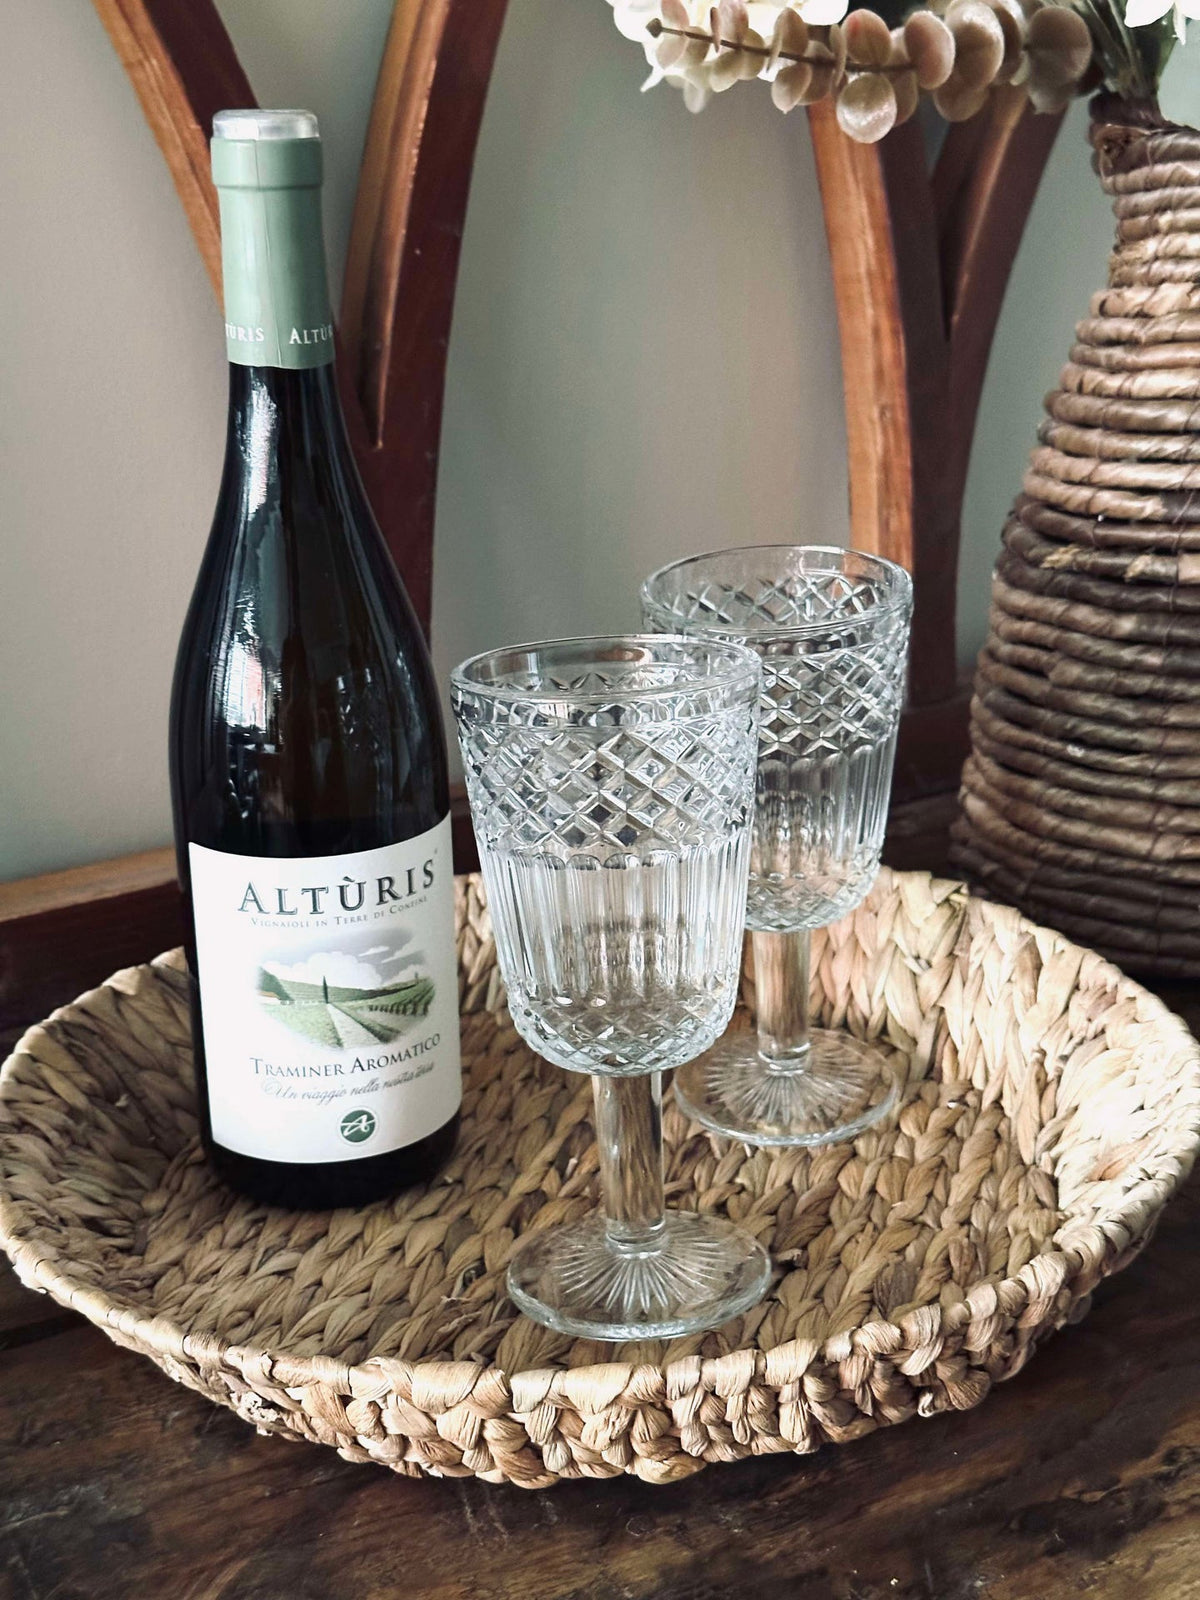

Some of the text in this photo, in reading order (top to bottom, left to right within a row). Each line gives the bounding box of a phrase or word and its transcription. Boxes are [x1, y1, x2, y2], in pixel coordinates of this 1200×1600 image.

[238, 859, 434, 916] ALTÙRIS
[251, 917, 309, 927] VIGNAIOLI
[334, 915, 368, 925] TERRE
[374, 910, 385, 919] DI
[250, 1057, 345, 1078] TRAMINER
[350, 1033, 441, 1074] AROMATICO
